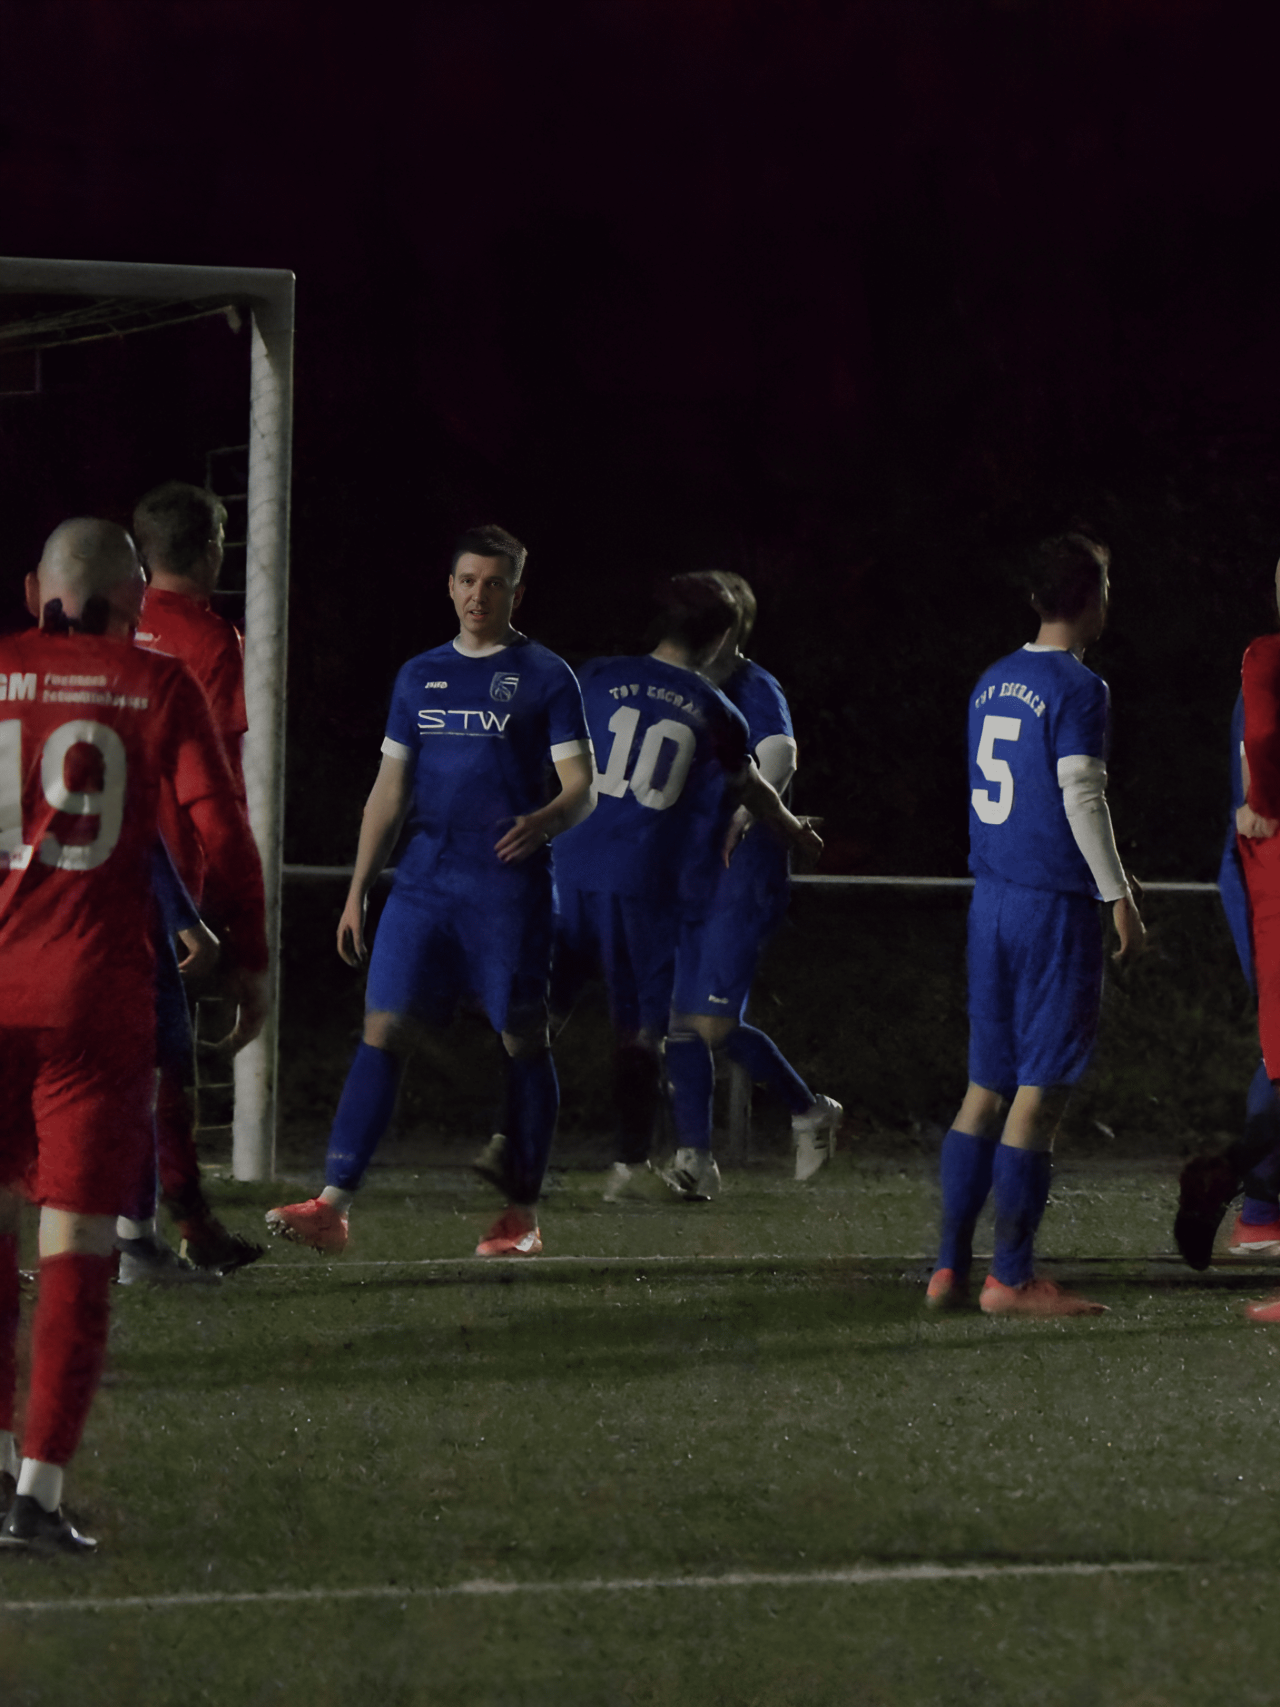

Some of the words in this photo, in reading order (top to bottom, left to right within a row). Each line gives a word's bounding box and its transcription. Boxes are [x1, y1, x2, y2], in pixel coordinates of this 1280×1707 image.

[417, 708, 511, 732] STW
[597, 705, 697, 811] 10
[971, 714, 1022, 825] 5
